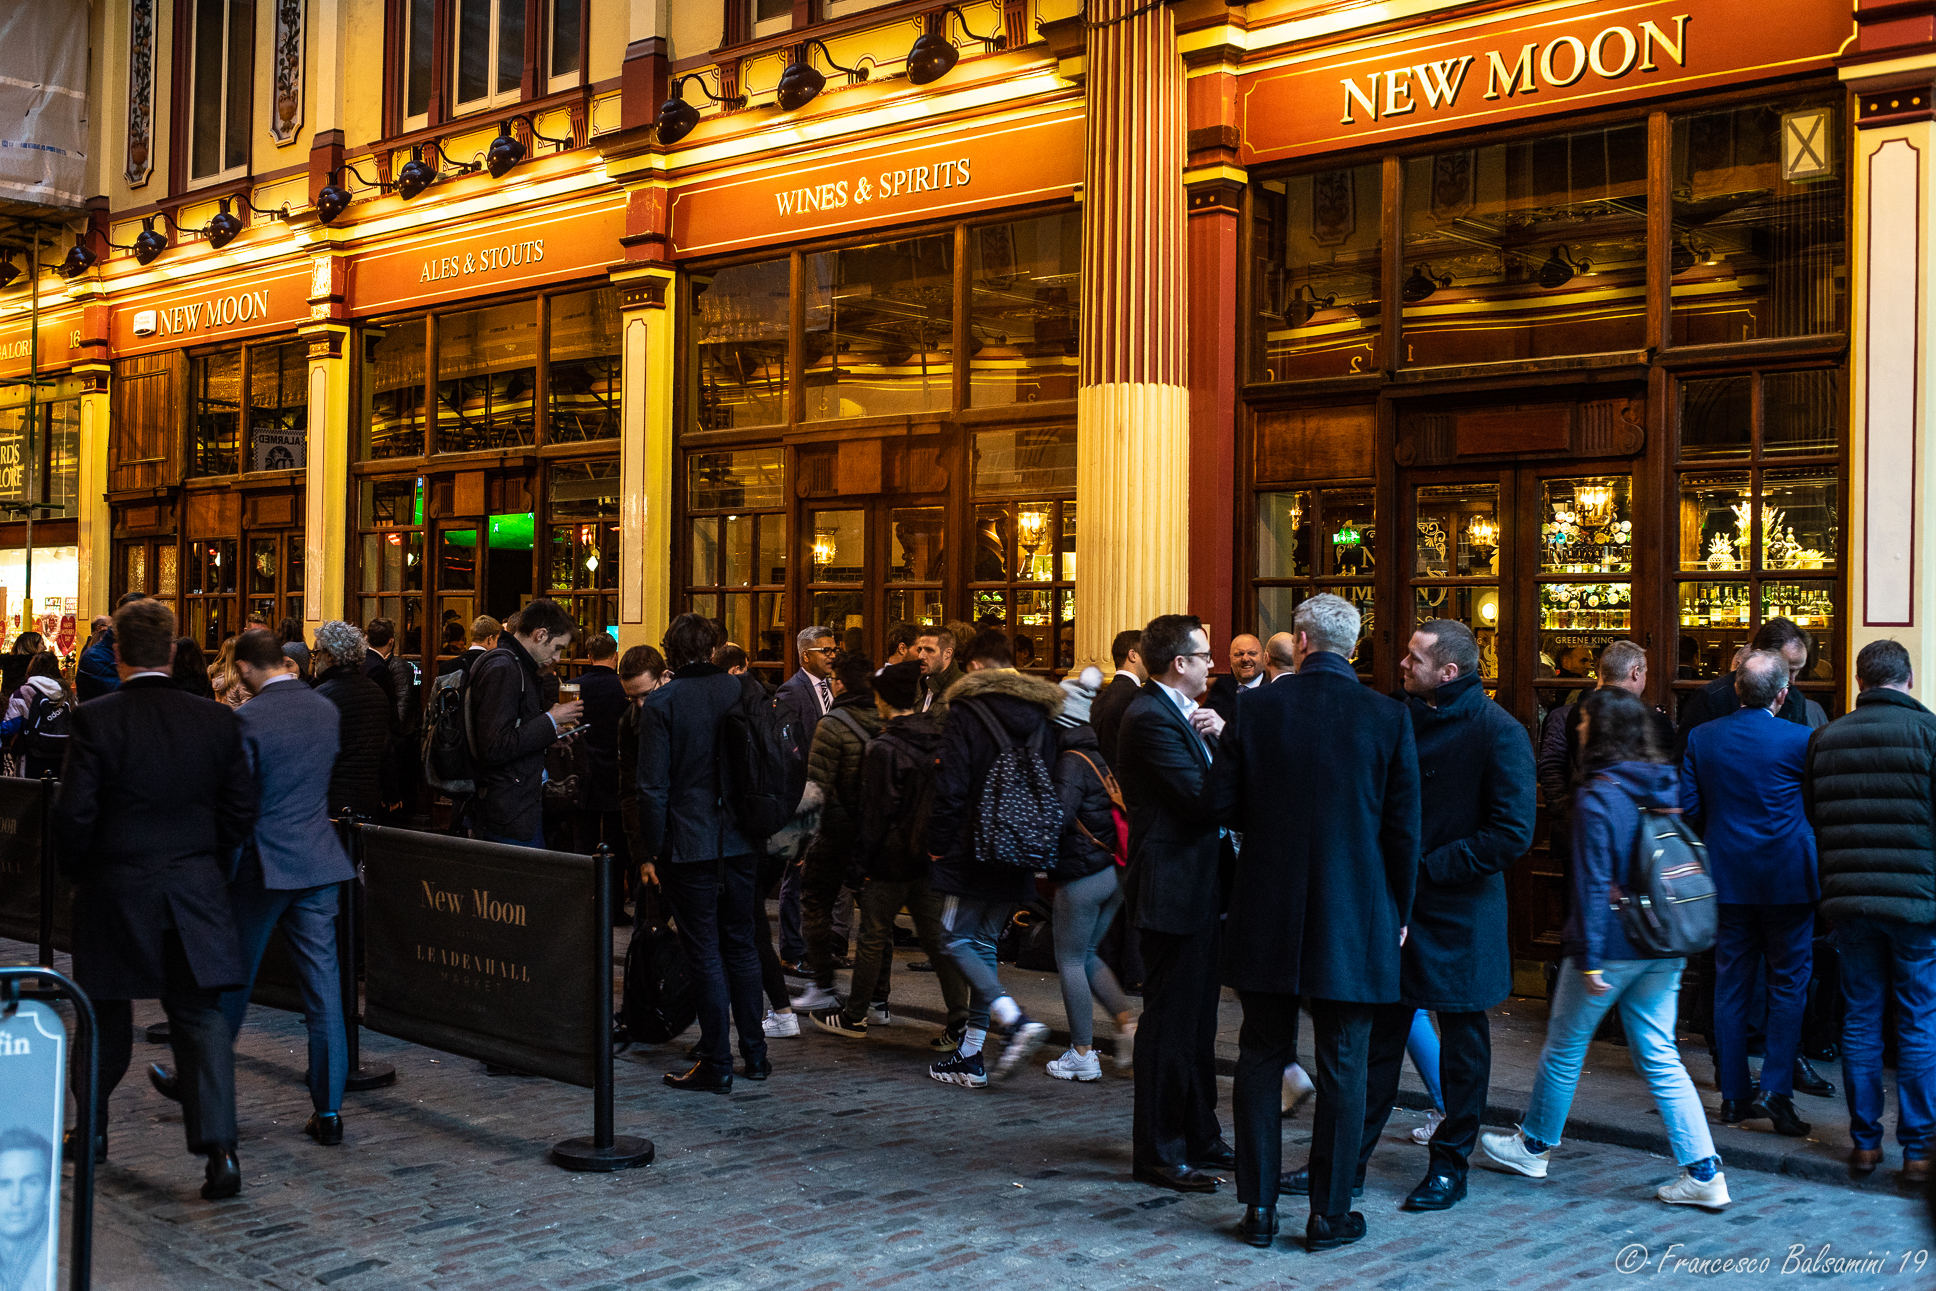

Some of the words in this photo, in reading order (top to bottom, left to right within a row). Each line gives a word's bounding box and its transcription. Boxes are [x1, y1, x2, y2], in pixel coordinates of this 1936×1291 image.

[1339, 54, 1475, 124] NEW
[1483, 13, 1692, 100] MOON
[775, 180, 849, 217] WINES
[854, 176, 874, 205] &
[879, 157, 971, 199] SPIRITS
[419, 255, 460, 283] ALES
[463, 252, 477, 275] &
[479, 239, 545, 272] STOUTS
[159, 302, 204, 337] NEW
[205, 290, 269, 328] MOON
[0, 339, 33, 361] ALOR
[69, 330, 81, 349] 16
[1555, 636, 1589, 645] GREENE
[1591, 636, 1614, 645] KING
[420, 880, 464, 914] New
[471, 889, 528, 926] Moon
[417, 944, 531, 983] LEADENHALL
[440, 971, 502, 993] MARKET
